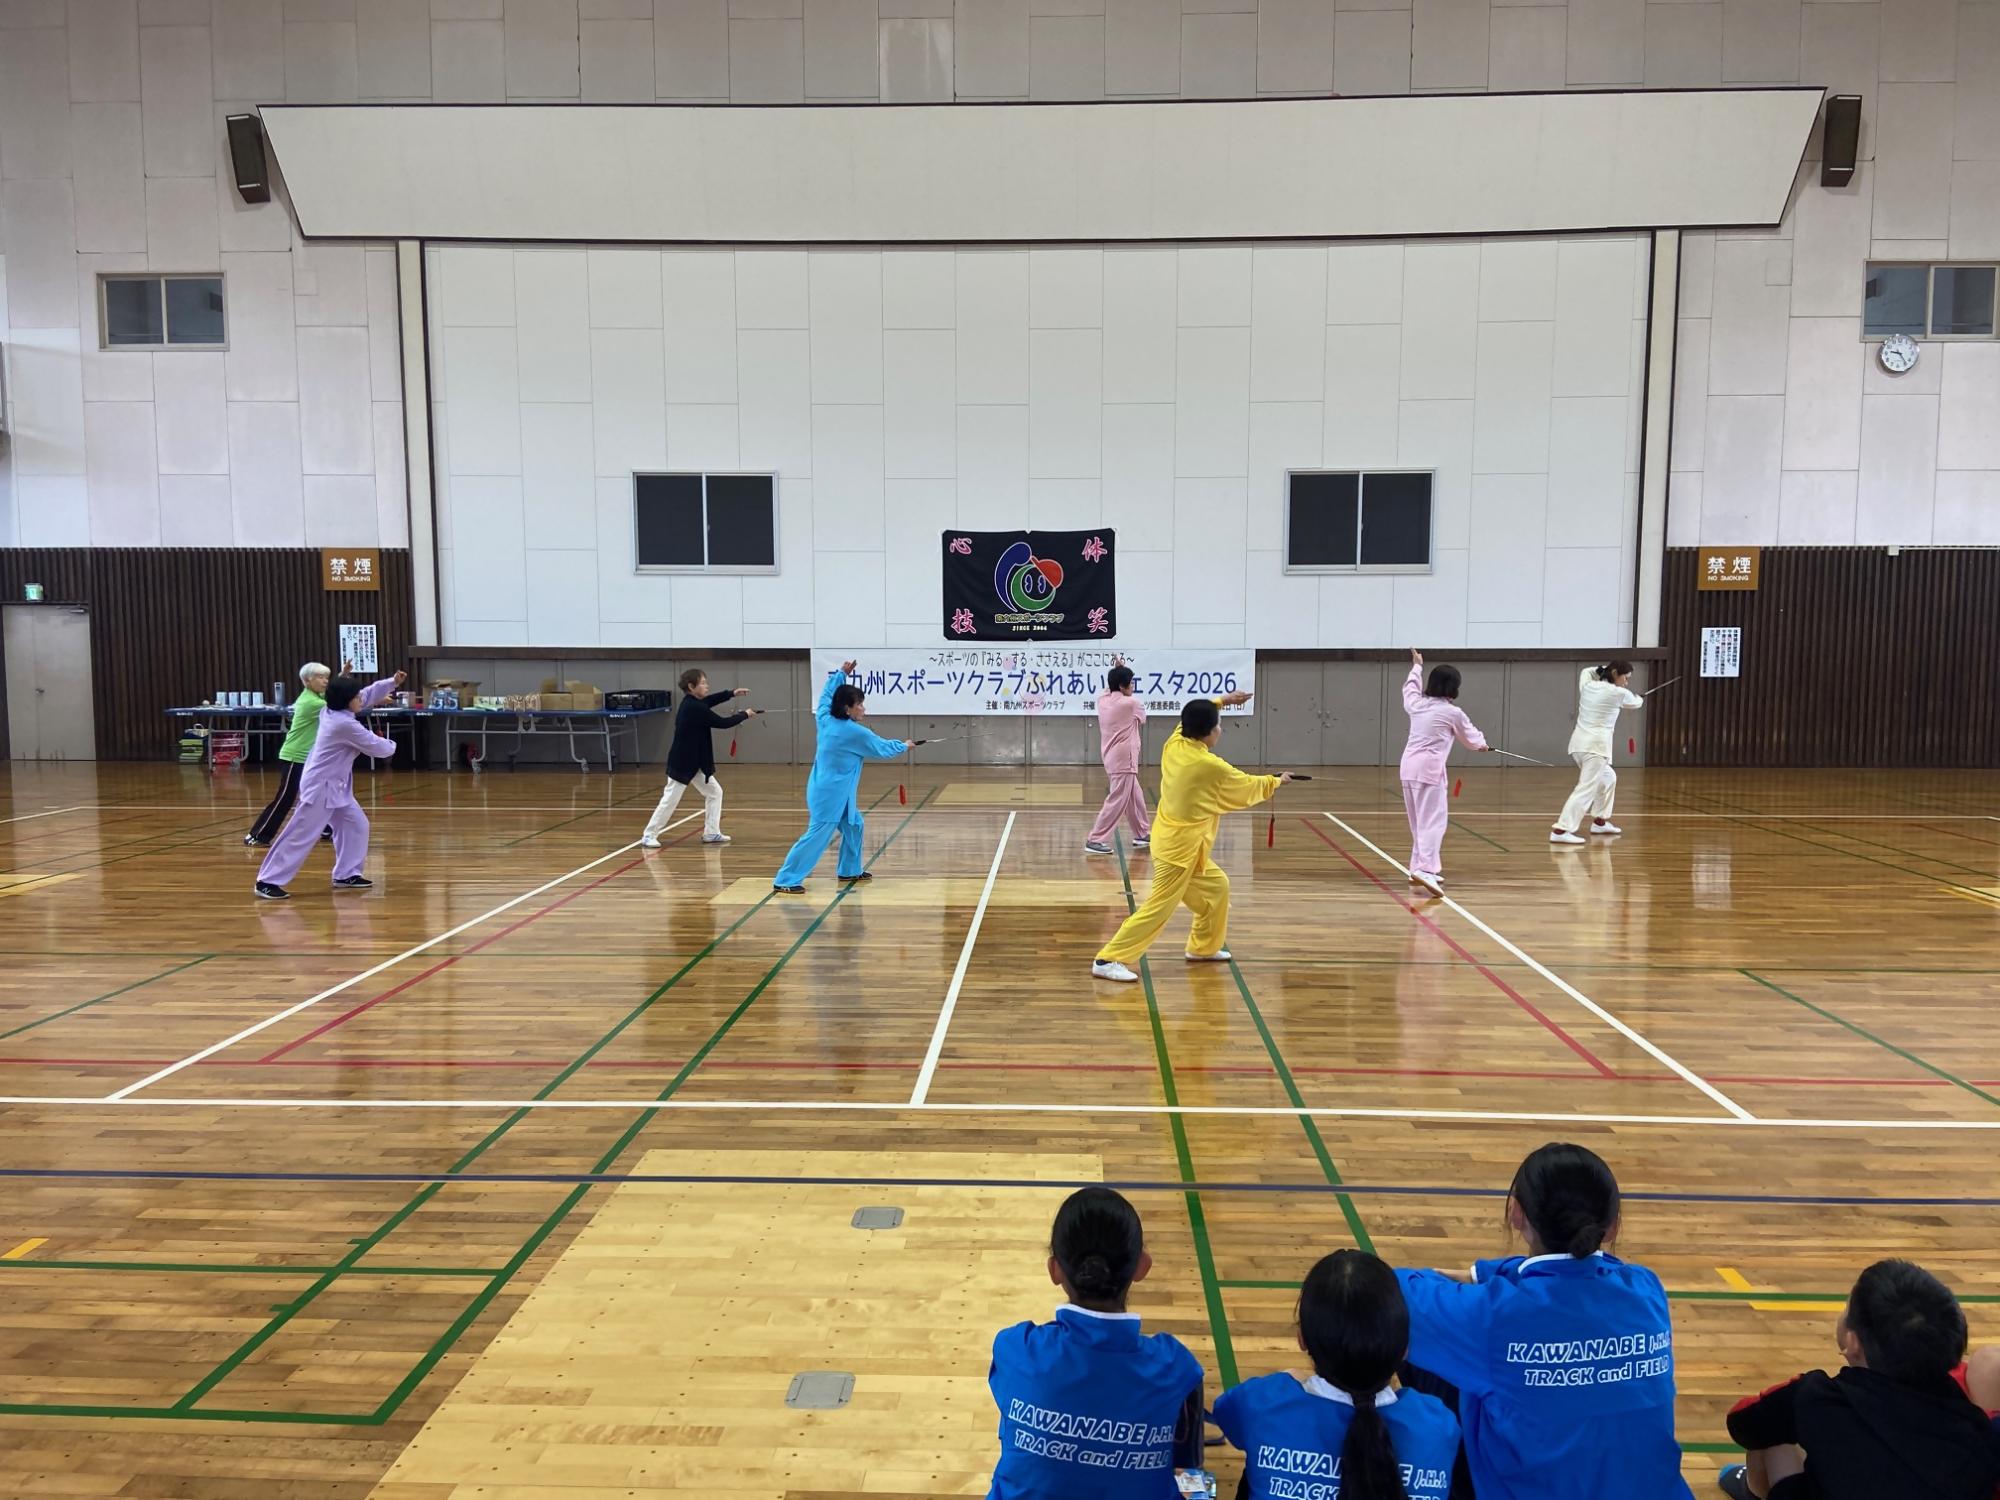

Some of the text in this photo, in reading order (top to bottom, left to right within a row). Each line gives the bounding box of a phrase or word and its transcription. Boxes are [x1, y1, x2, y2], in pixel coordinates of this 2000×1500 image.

[949, 537, 972, 555] 心
[1082, 536, 1108, 563] 体
[330, 557, 372, 575] 禁煙
[1707, 556, 1751, 574] 禁煙
[950, 607, 977, 634] 技
[1087, 606, 1109, 633] 笑
[1507, 1334, 1646, 1364] KAWANABE
[1525, 1355, 1670, 1387] TRACK and FIELD
[1008, 1398, 1148, 1446] KAWANABE
[1014, 1428, 1078, 1462] TRACK
[1078, 1450, 1124, 1469] and
